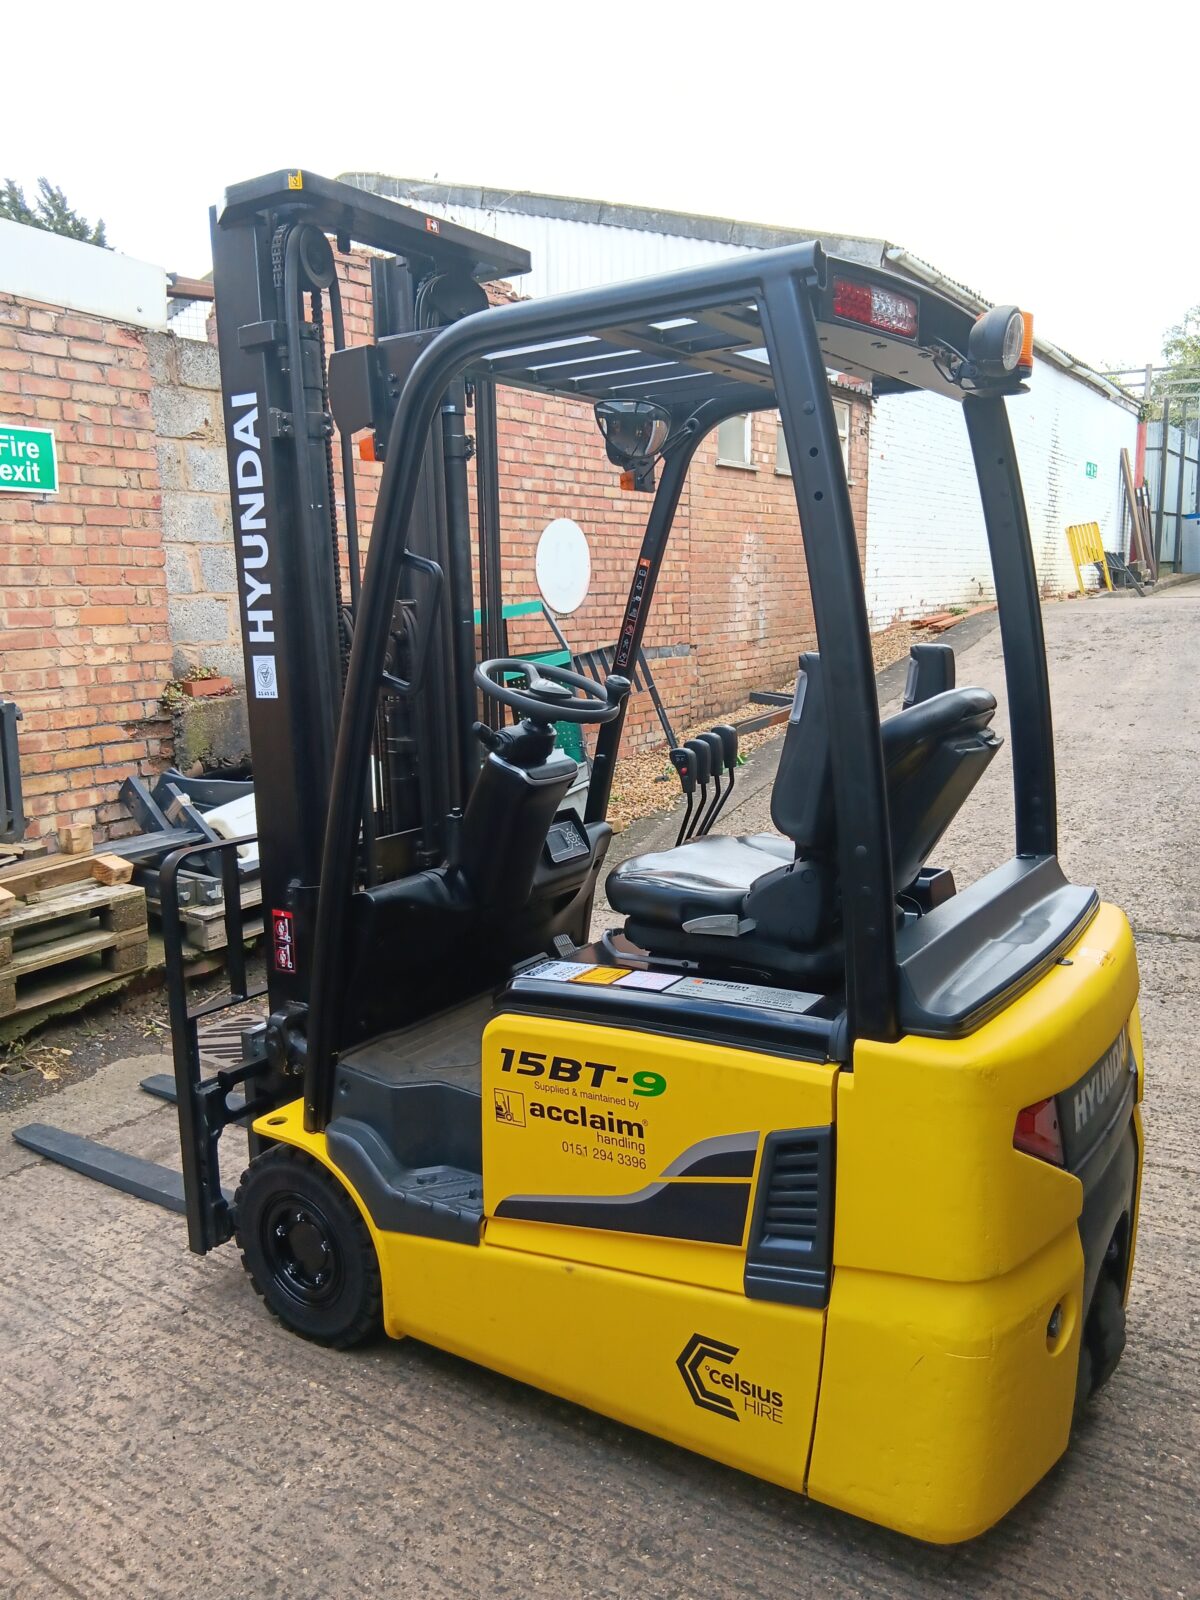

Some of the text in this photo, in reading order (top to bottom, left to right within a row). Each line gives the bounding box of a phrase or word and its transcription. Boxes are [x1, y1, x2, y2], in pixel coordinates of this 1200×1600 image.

[0, 435, 40, 459] Fire
[0, 461, 41, 483] exit
[231, 392, 275, 642] HYUNDAI
[500, 1048, 667, 1097] 15BT-9
[534, 1081, 640, 1111] Supplied & maintained by
[561, 1141, 647, 1170] 0151 294 3396
[596, 1132, 646, 1155] handling
[744, 1396, 784, 1425] HIRE
